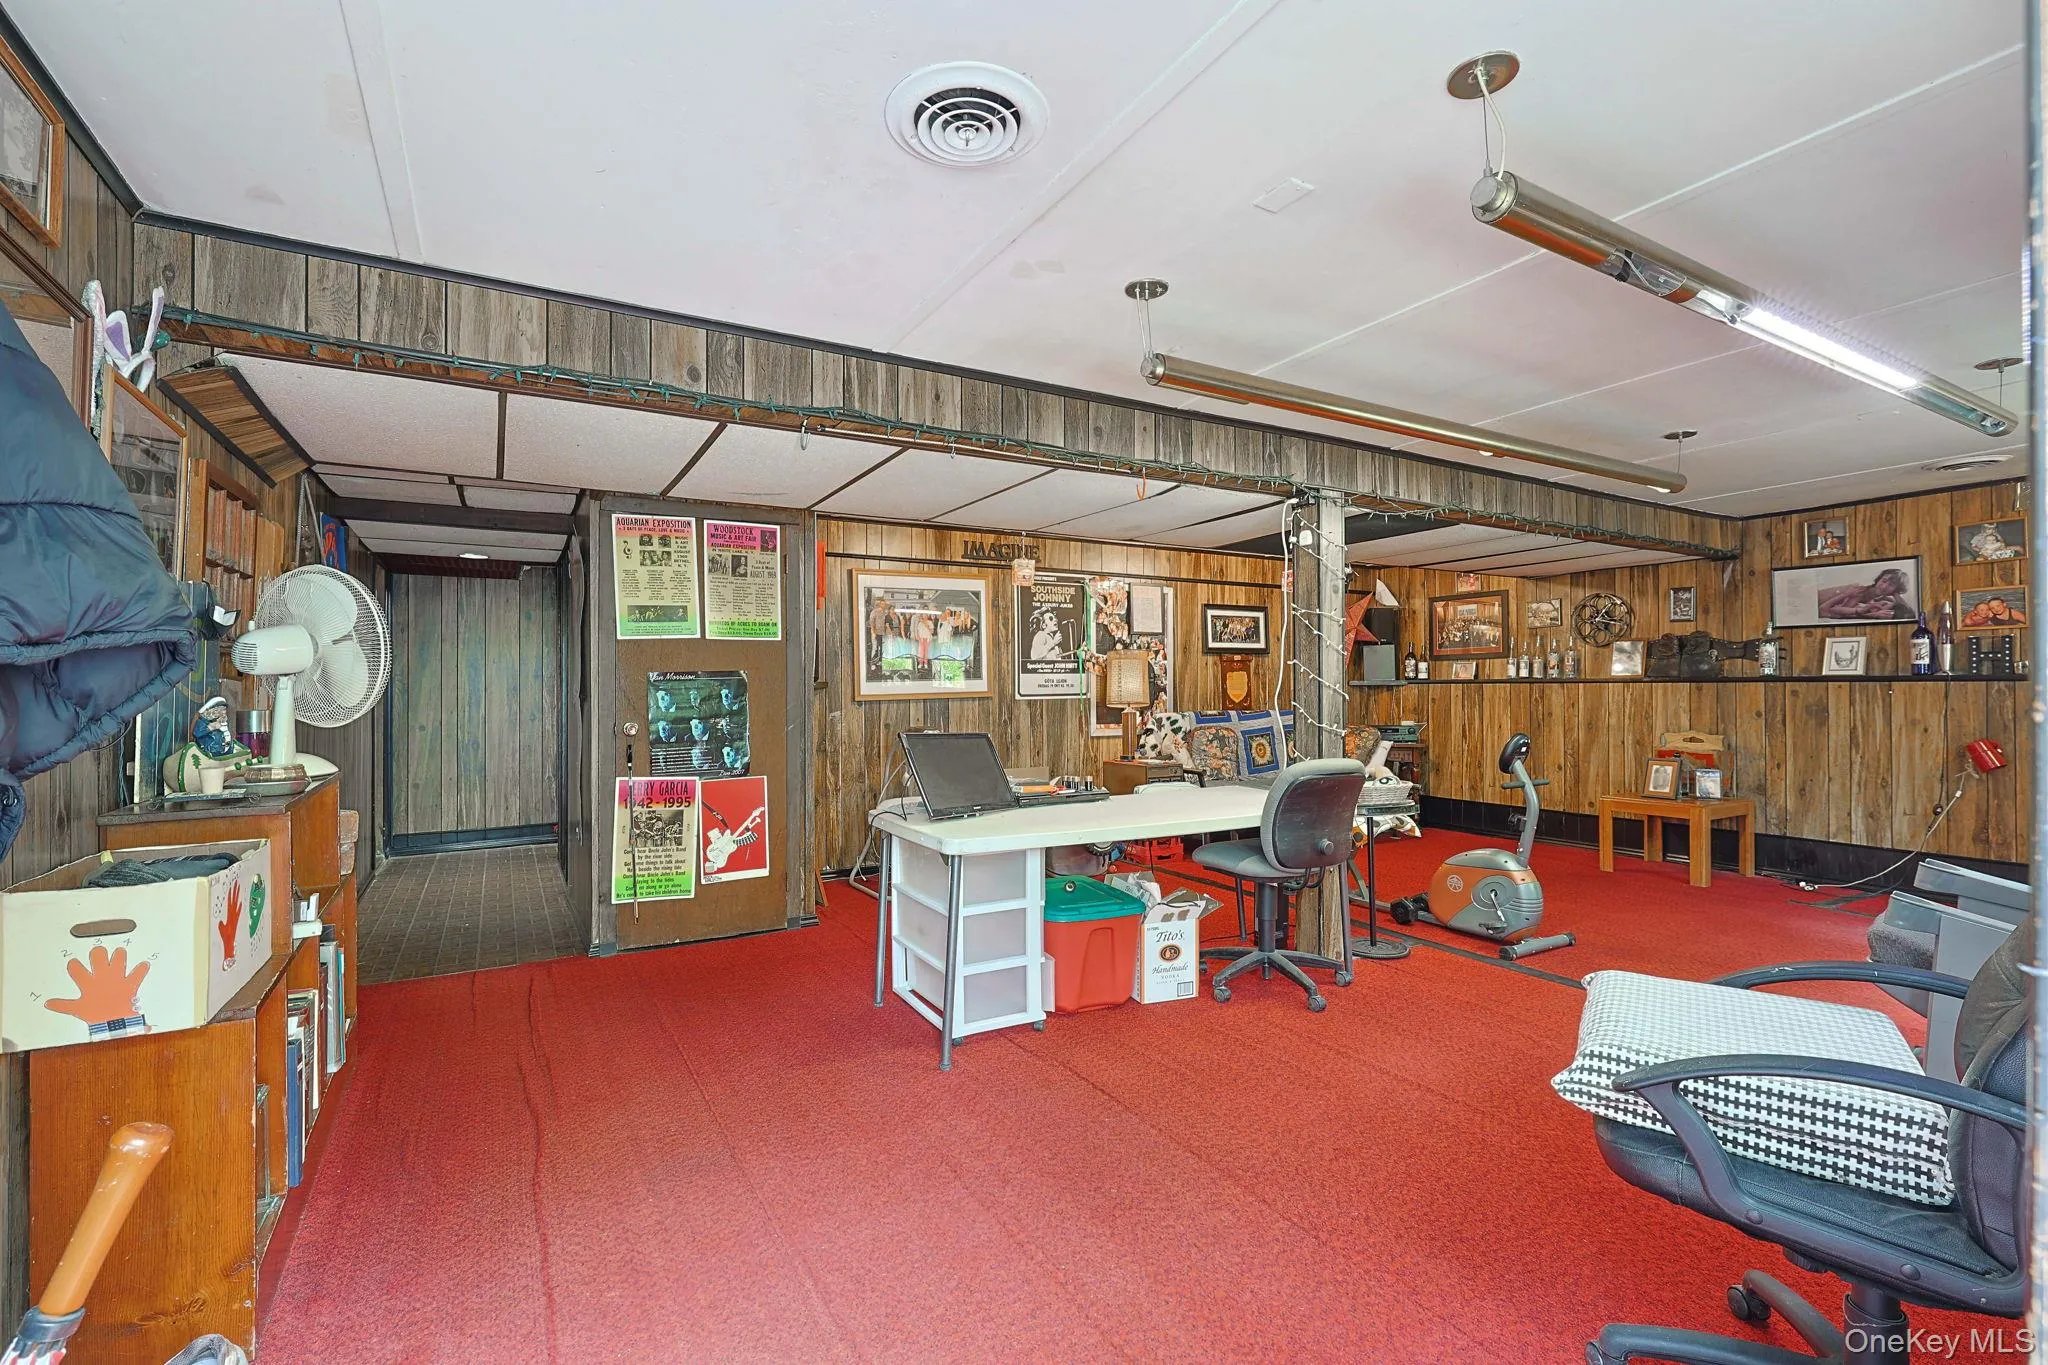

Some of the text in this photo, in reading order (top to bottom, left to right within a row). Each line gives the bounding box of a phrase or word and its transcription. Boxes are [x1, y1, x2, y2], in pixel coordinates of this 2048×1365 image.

[616, 517, 691, 528] AQUARIAN EXPOSITION
[714, 525, 754, 535] WOODSTOCK
[962, 540, 1041, 561] IMAGINE
[1031, 585, 1075, 594] SOUTHSIDE
[1033, 593, 1071, 603] JOHNNY
[649, 672, 695, 682] Van Morrison
[628, 781, 688, 796] ERRY GARCIA
[1156, 930, 1184, 942] Tito's
[61, 949, 73, 957] 2
[147, 952, 160, 961] 5
[1152, 962, 1188, 974] Handmade
